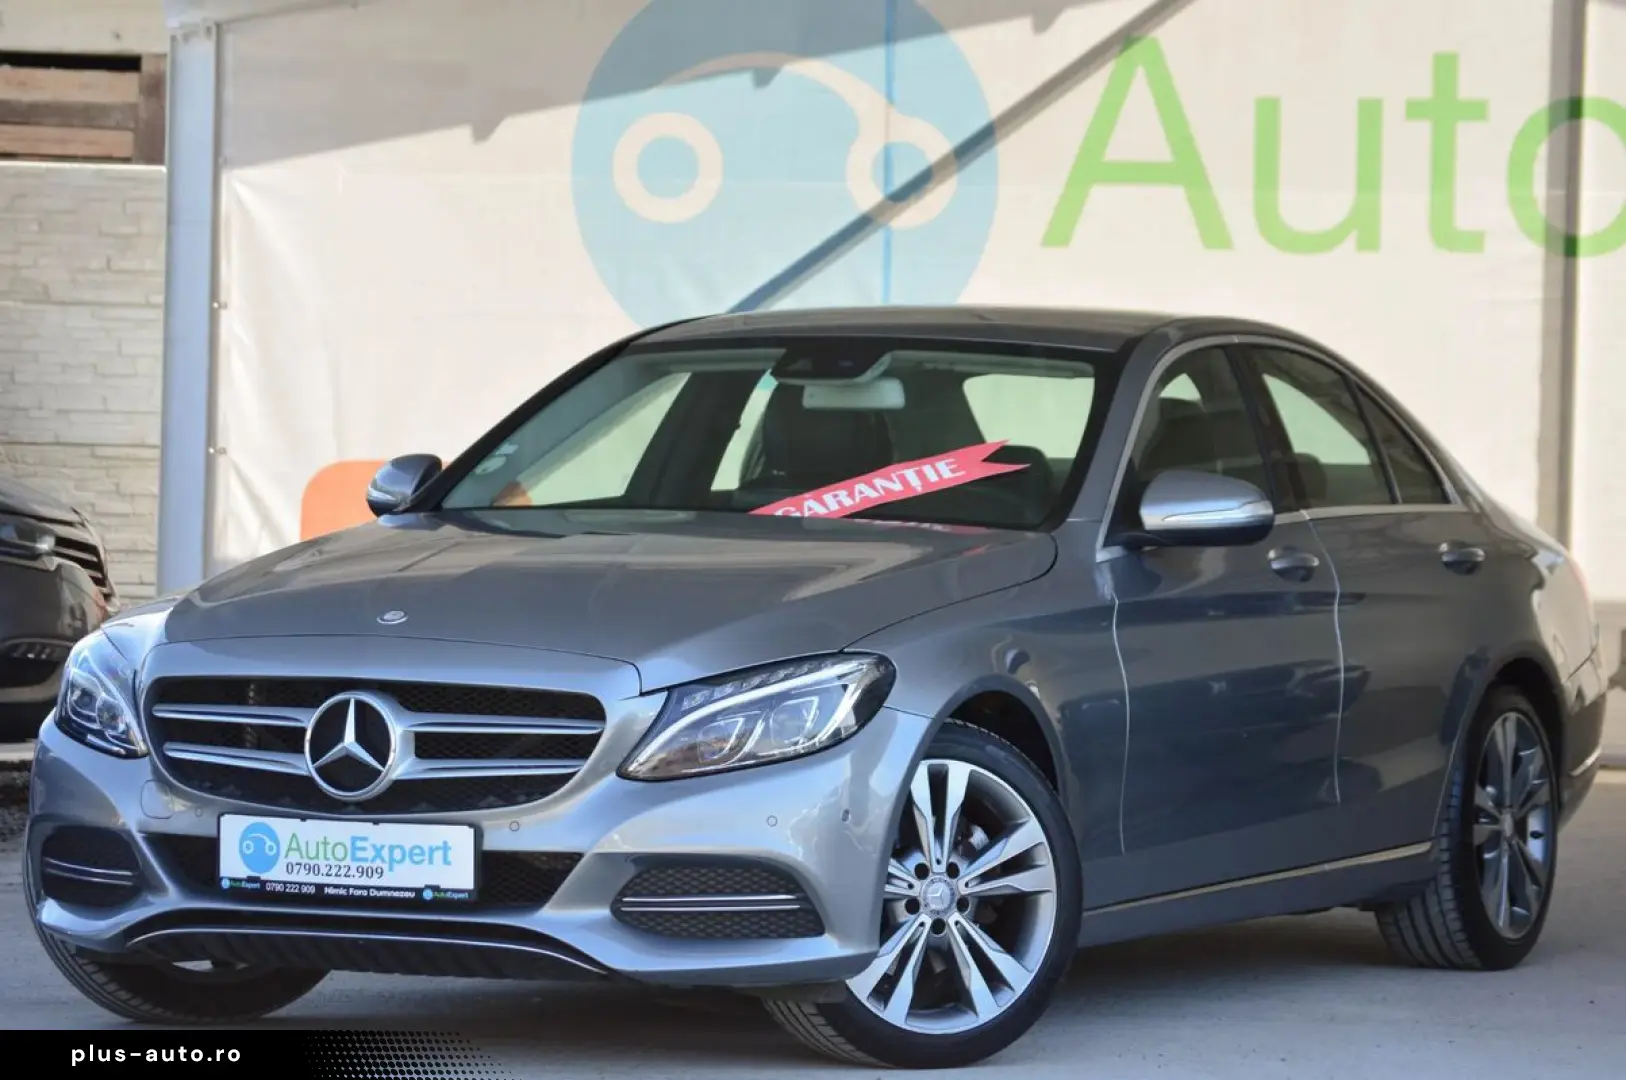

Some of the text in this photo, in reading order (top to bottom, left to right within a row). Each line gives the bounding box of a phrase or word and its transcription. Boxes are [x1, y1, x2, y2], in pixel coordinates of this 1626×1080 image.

[1040, 35, 1626, 258] Auto
[284, 833, 452, 871] AutoExpert
[286, 862, 385, 879] 0790.222.909
[265, 882, 316, 894] 0790 222 909
[324, 886, 347, 895] Nimic
